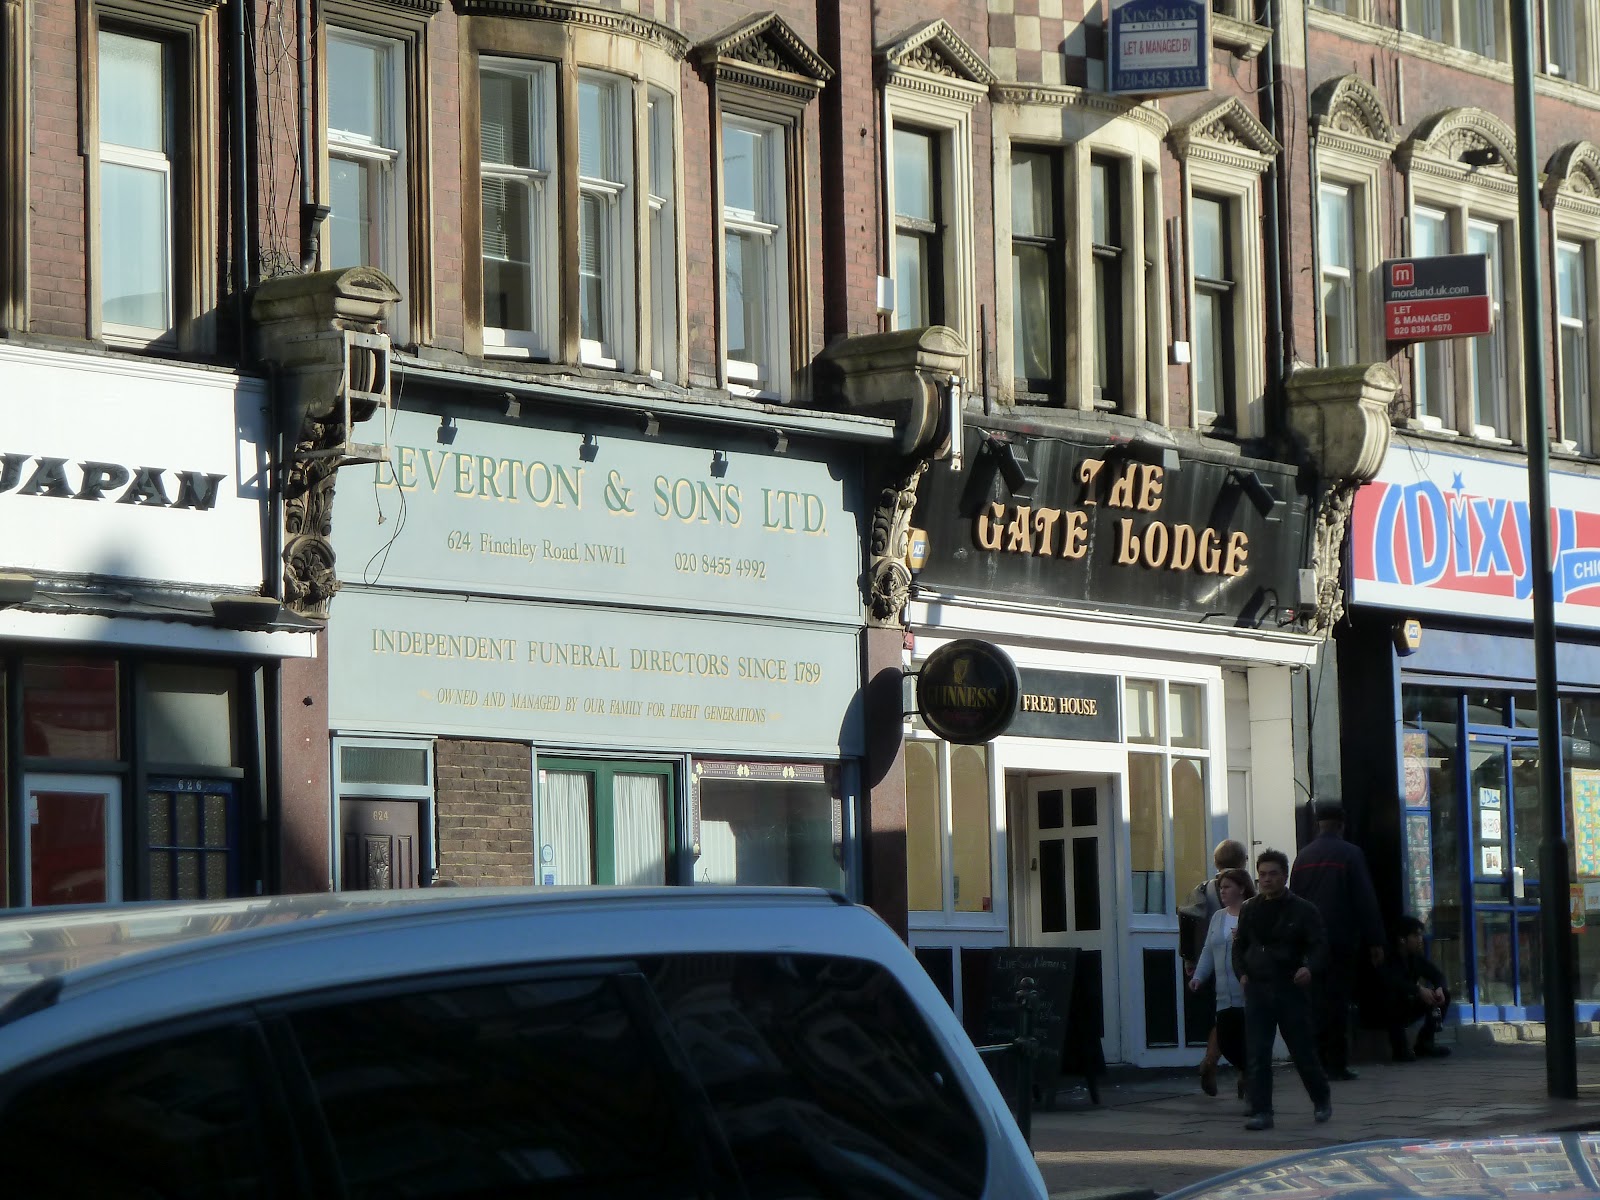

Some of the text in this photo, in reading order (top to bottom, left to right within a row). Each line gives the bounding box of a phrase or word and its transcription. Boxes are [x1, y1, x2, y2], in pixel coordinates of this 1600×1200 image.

[1124, 38, 1191, 55] LET & MANAGED BY
[1173, 69, 1200, 85] 3333
[1392, 285, 1469, 298] moreland.uk.com
[1394, 306, 1411, 314] LET
[1403, 313, 1450, 324] MANAGED
[1394, 324, 1452, 335] 020 8381 4970
[0, 453, 227, 511] JAPAN
[372, 442, 828, 536] LEVERTON & SONS LTD.
[1080, 458, 1164, 512] THE
[480, 532, 536, 564] Finchley
[584, 543, 626, 567] NW11
[978, 502, 1249, 577] GATE LODGE
[674, 552, 767, 580] 020 8455 4992
[1574, 559, 1600, 579] CHI
[372, 628, 822, 684] INDEPENDENT FUNERAL DIRECTORS SINCE 1789
[437, 687, 766, 723] OWNED AND MANAGED BY OUR FAMILY FOR EIGHT GENERATIONS
[1022, 694, 1098, 716] FREE HOUSE
[177, 779, 202, 791] 626
[373, 810, 388, 821] 624
